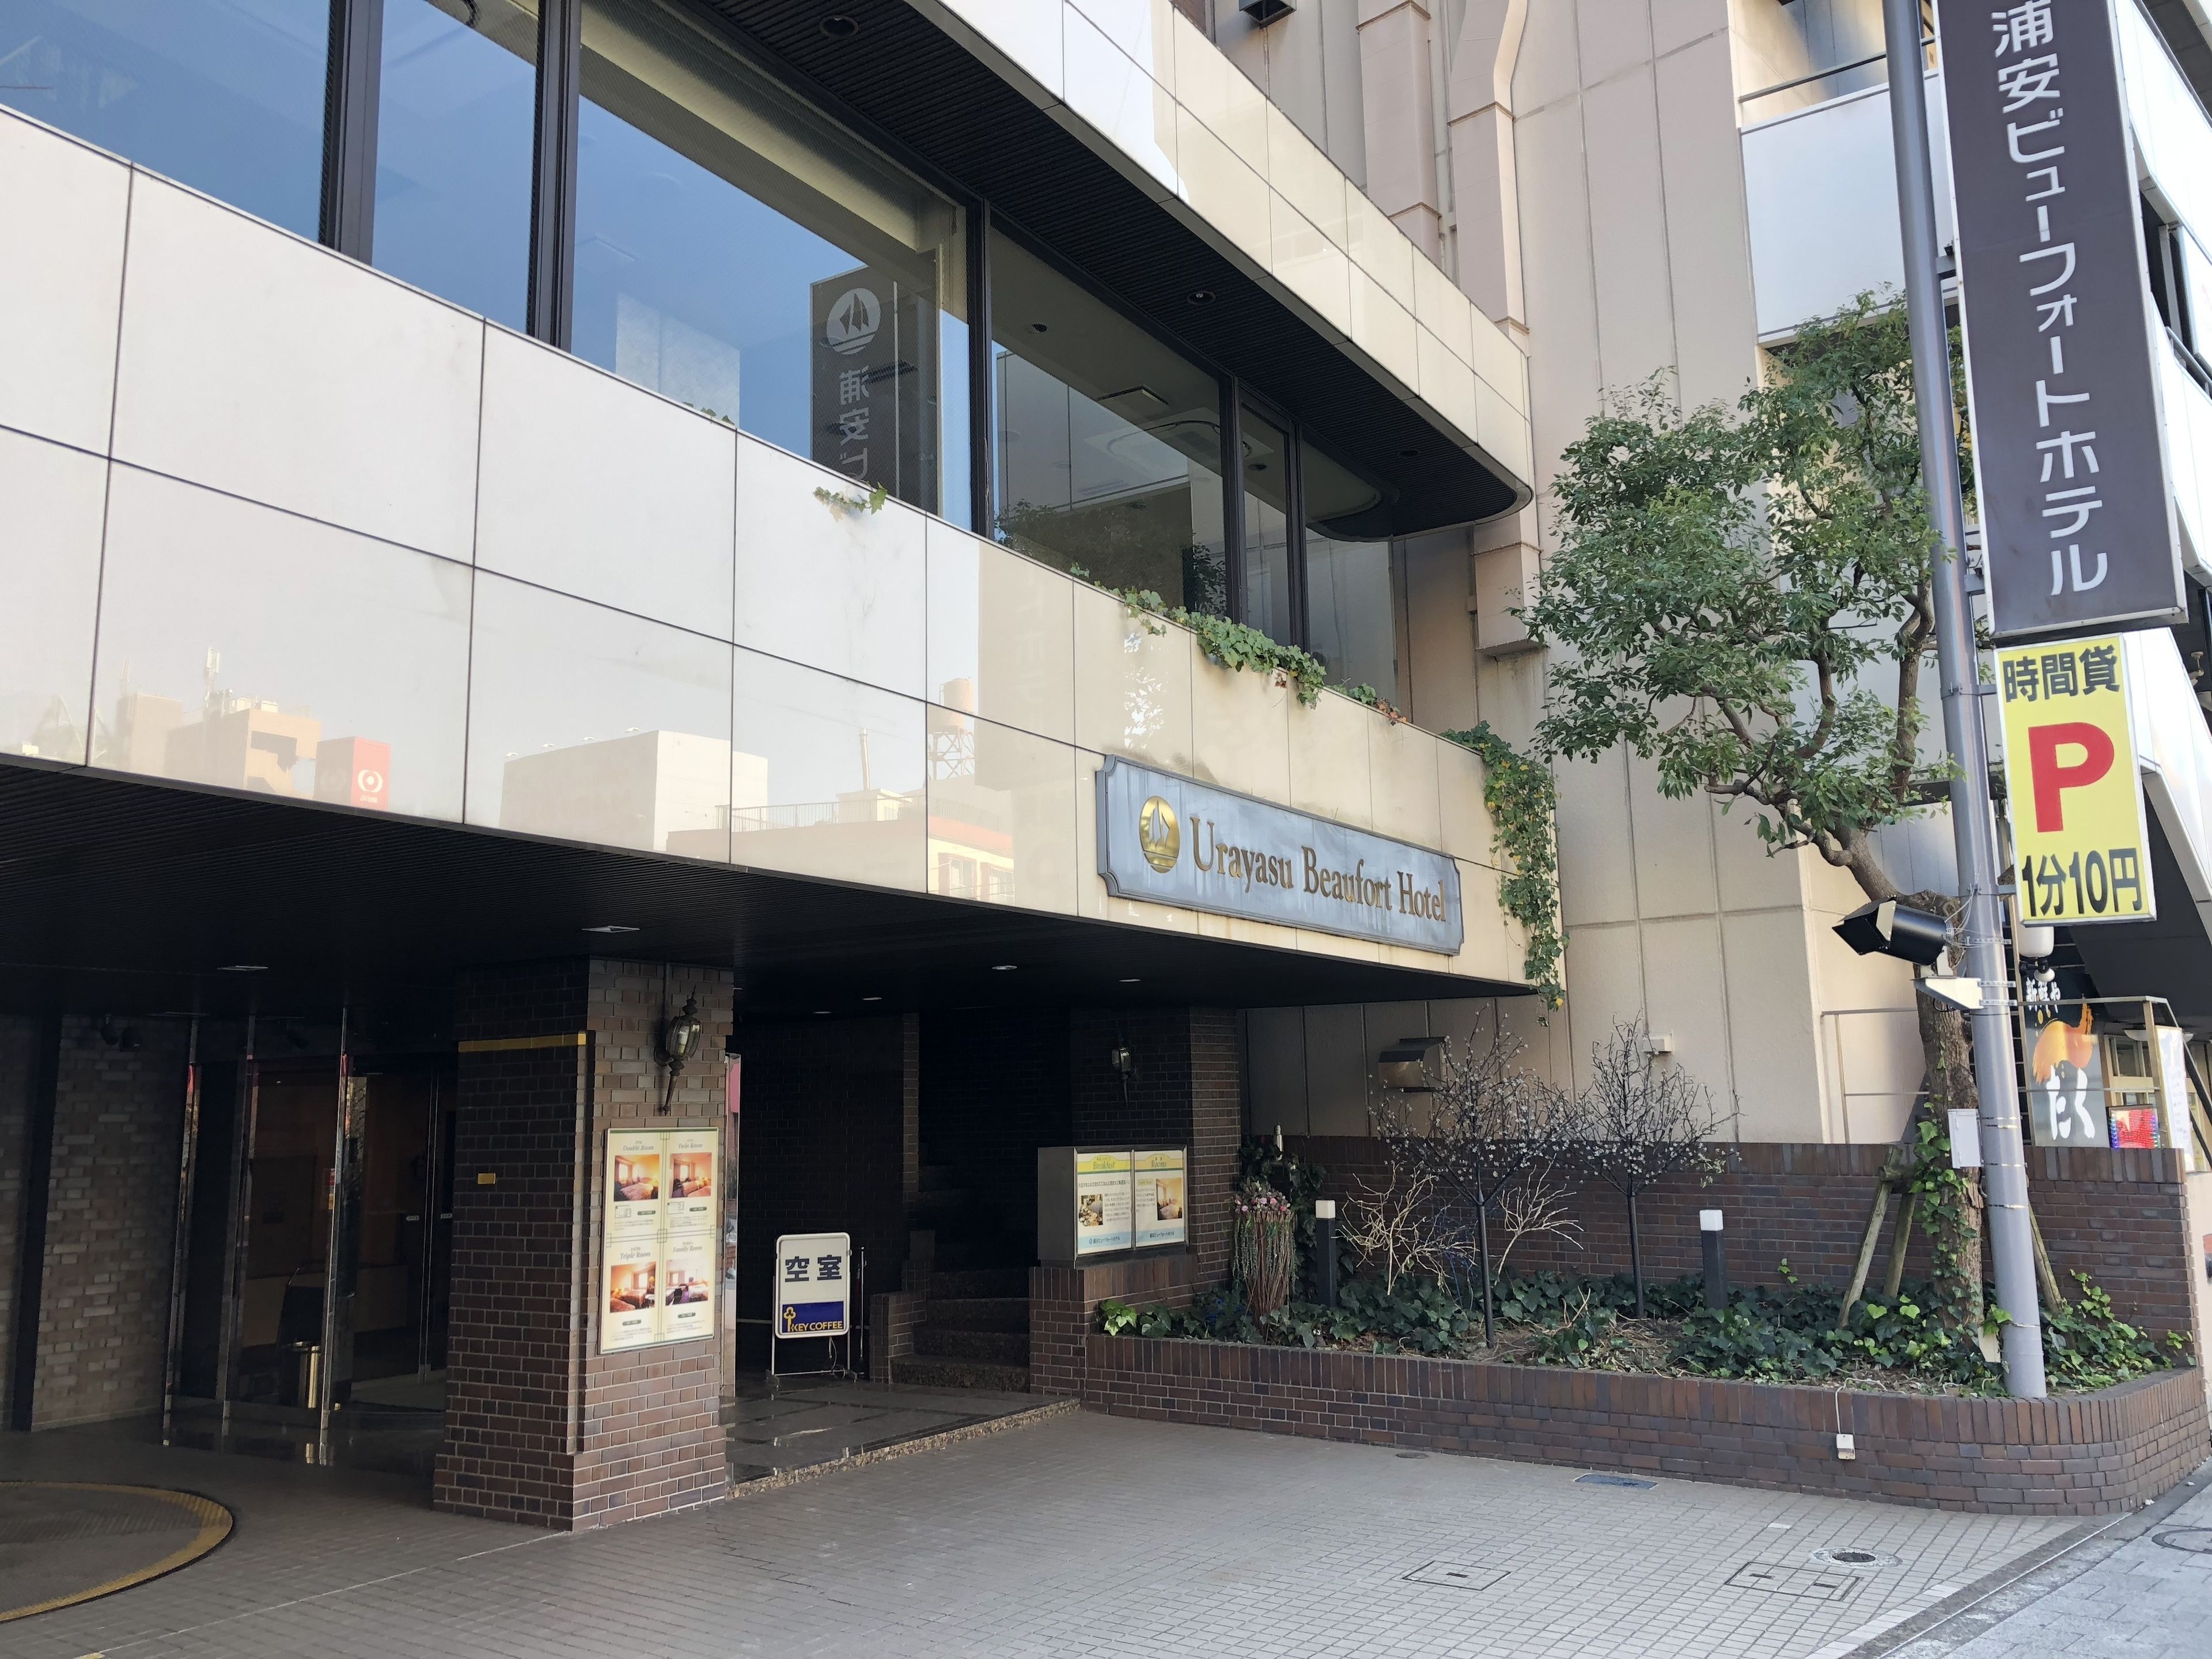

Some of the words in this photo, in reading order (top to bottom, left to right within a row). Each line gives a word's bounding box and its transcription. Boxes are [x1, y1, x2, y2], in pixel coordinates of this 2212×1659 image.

[1991, 0, 2108, 596] 浦安ビューフォートホテル
[2002, 645, 2120, 703] 時間貸
[2028, 722, 2115, 833] P
[1190, 816, 1294, 893] Urayasu
[1301, 845, 1392, 911] Beaufort
[1397, 871, 1446, 922] Hotel
[2022, 847, 2142, 917] 1分10円
[1093, 1161, 1115, 1170] Breakfast
[620, 1252, 635, 1260] Triple
[785, 1255, 842, 1282] 空室
[791, 1323, 809, 1332] KEY
[809, 1320, 843, 1331] COFFEE
